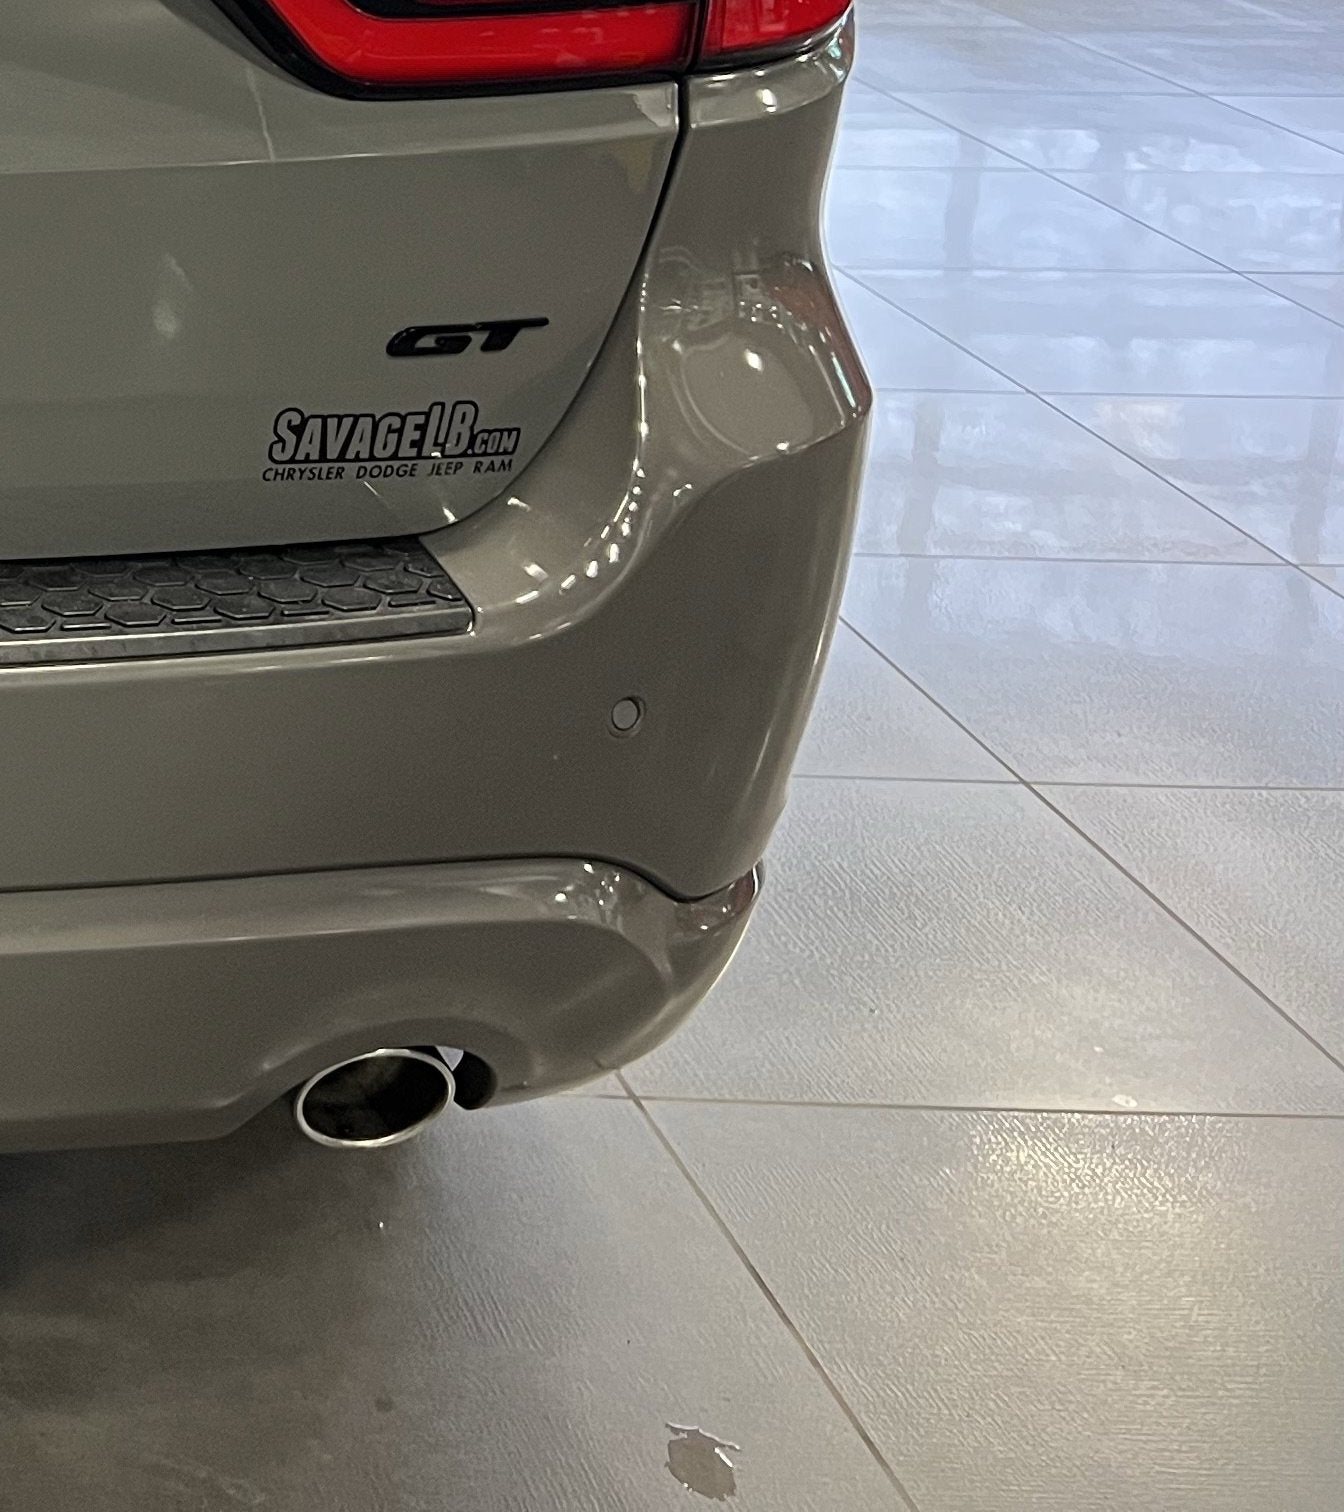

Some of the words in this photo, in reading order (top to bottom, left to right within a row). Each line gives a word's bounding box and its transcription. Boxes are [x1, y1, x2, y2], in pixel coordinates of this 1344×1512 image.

[385, 316, 550, 357] GT
[262, 465, 345, 483] CHRYSLER
[355, 463, 418, 480] DODGE
[427, 461, 464, 477] JEEP
[472, 459, 513, 475] RAM
